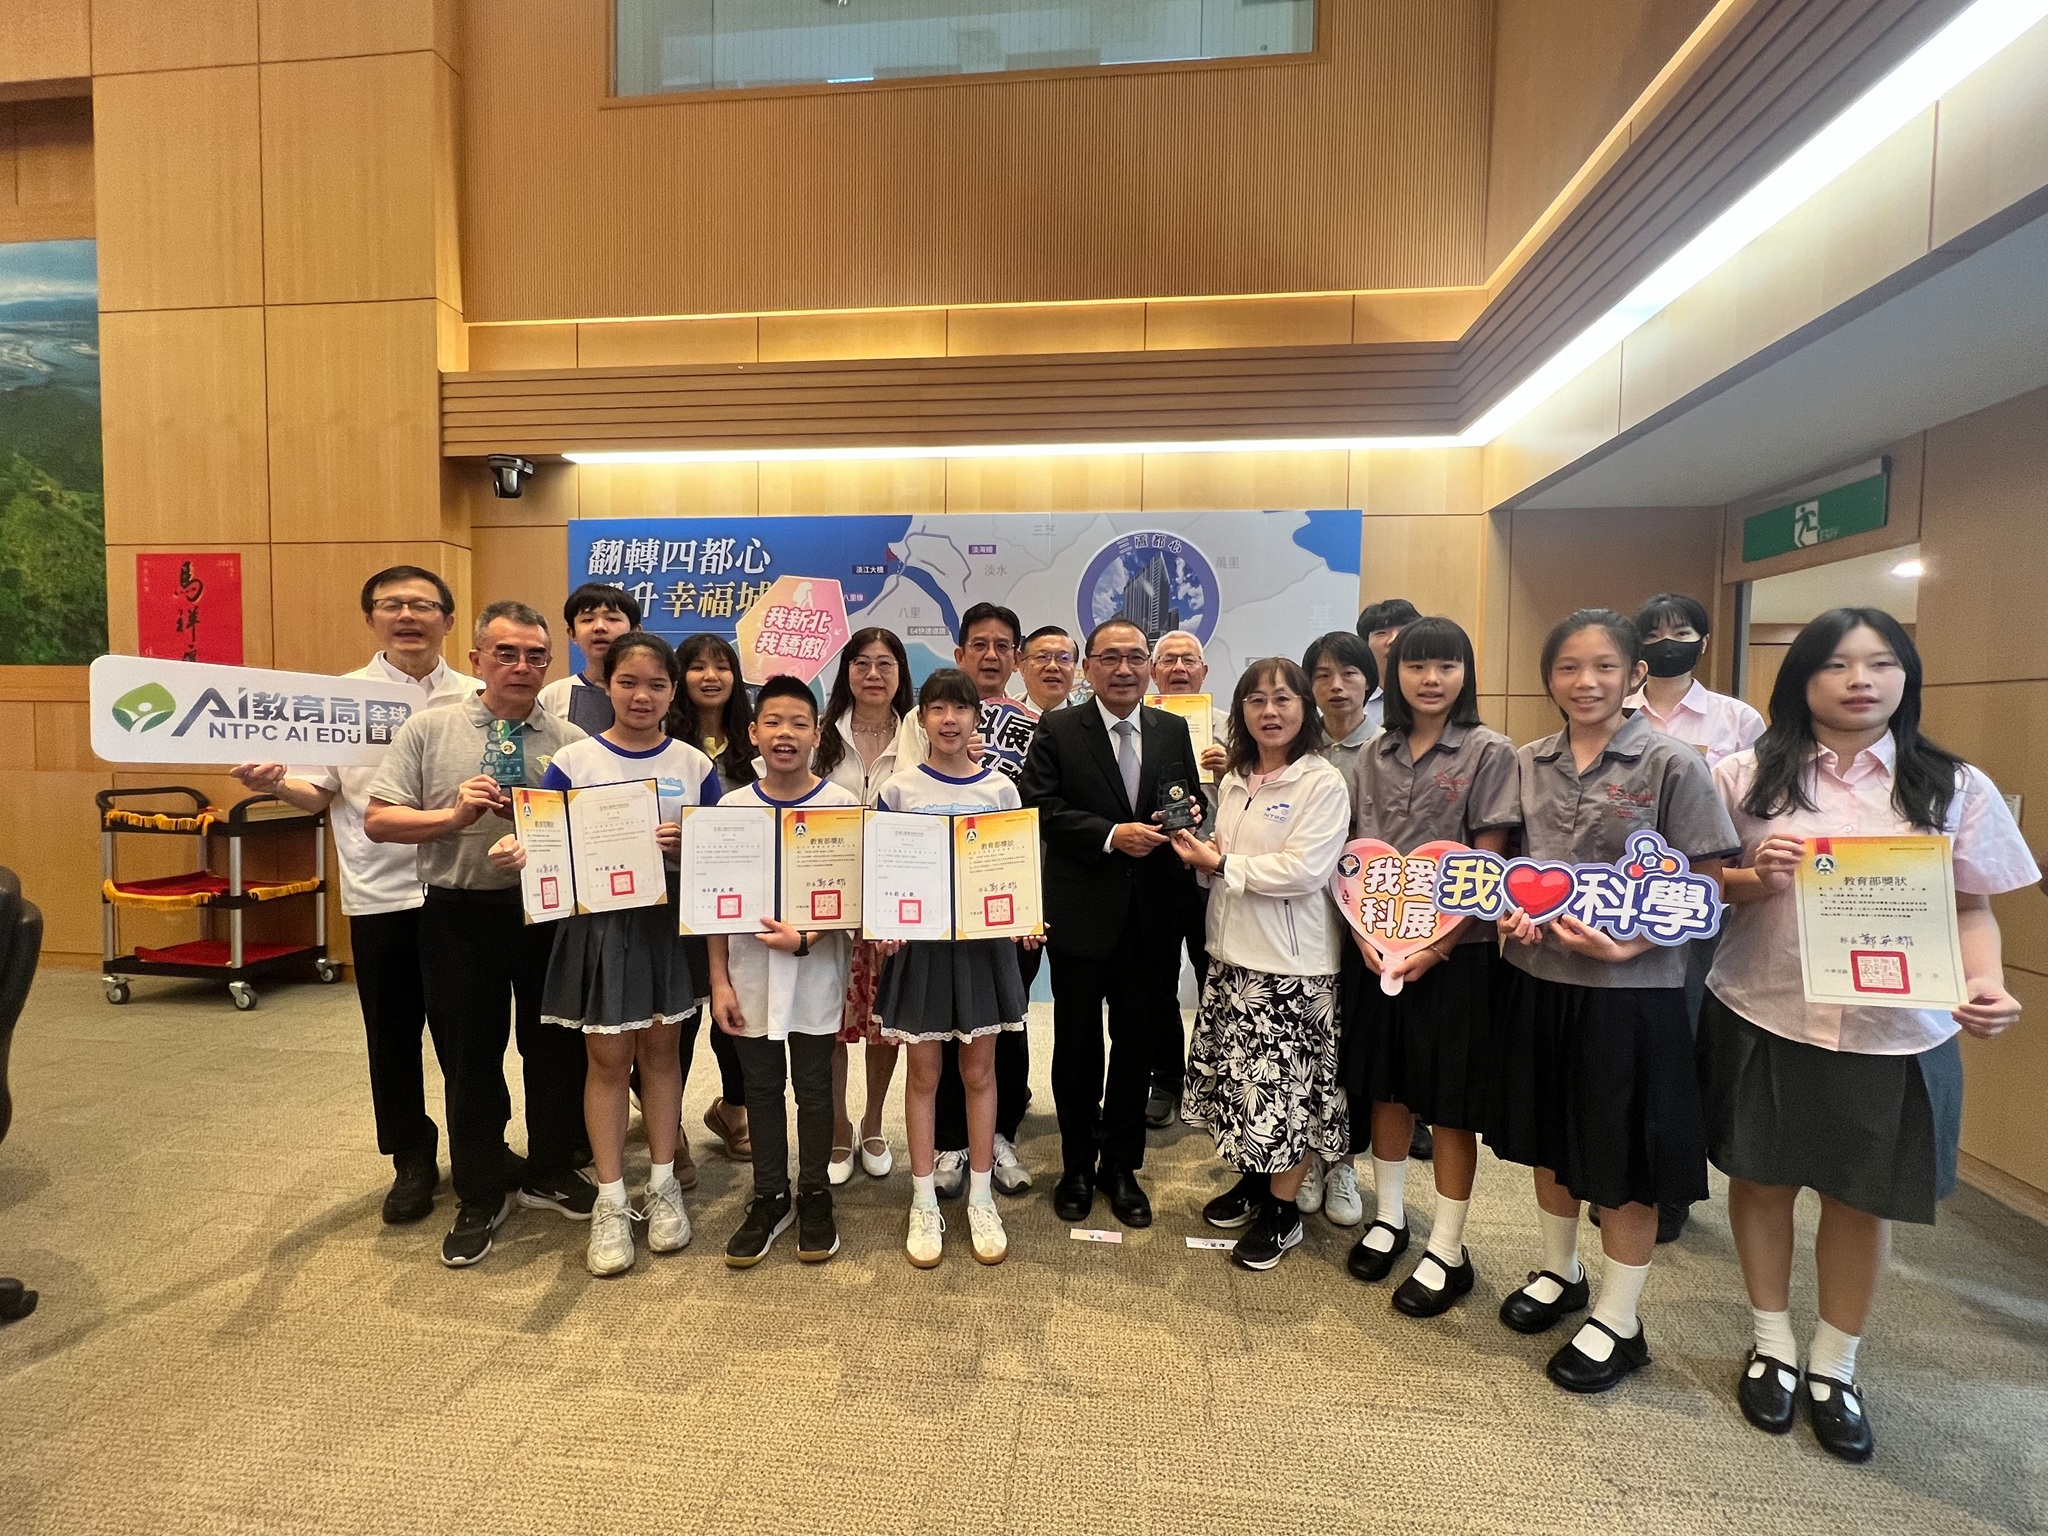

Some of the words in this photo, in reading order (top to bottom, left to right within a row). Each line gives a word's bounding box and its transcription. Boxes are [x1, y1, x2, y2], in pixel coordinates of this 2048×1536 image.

[588, 538, 771, 575] 翻轉四都心
[984, 564, 1008, 576] 淡水
[1216, 556, 1239, 569] 萬里
[765, 606, 833, 634] 我新北
[898, 606, 921, 619] 八里
[756, 631, 826, 662] 我驕傲
[369, 704, 409, 723] 全球
[208, 722, 278, 741] NTPC
[285, 727, 308, 742] AI
[316, 728, 361, 744] EDU
[1364, 856, 1437, 896] 我愛
[1442, 858, 1501, 911] 我
[1572, 872, 1708, 935] 科學
[1360, 897, 1437, 939] 科展
